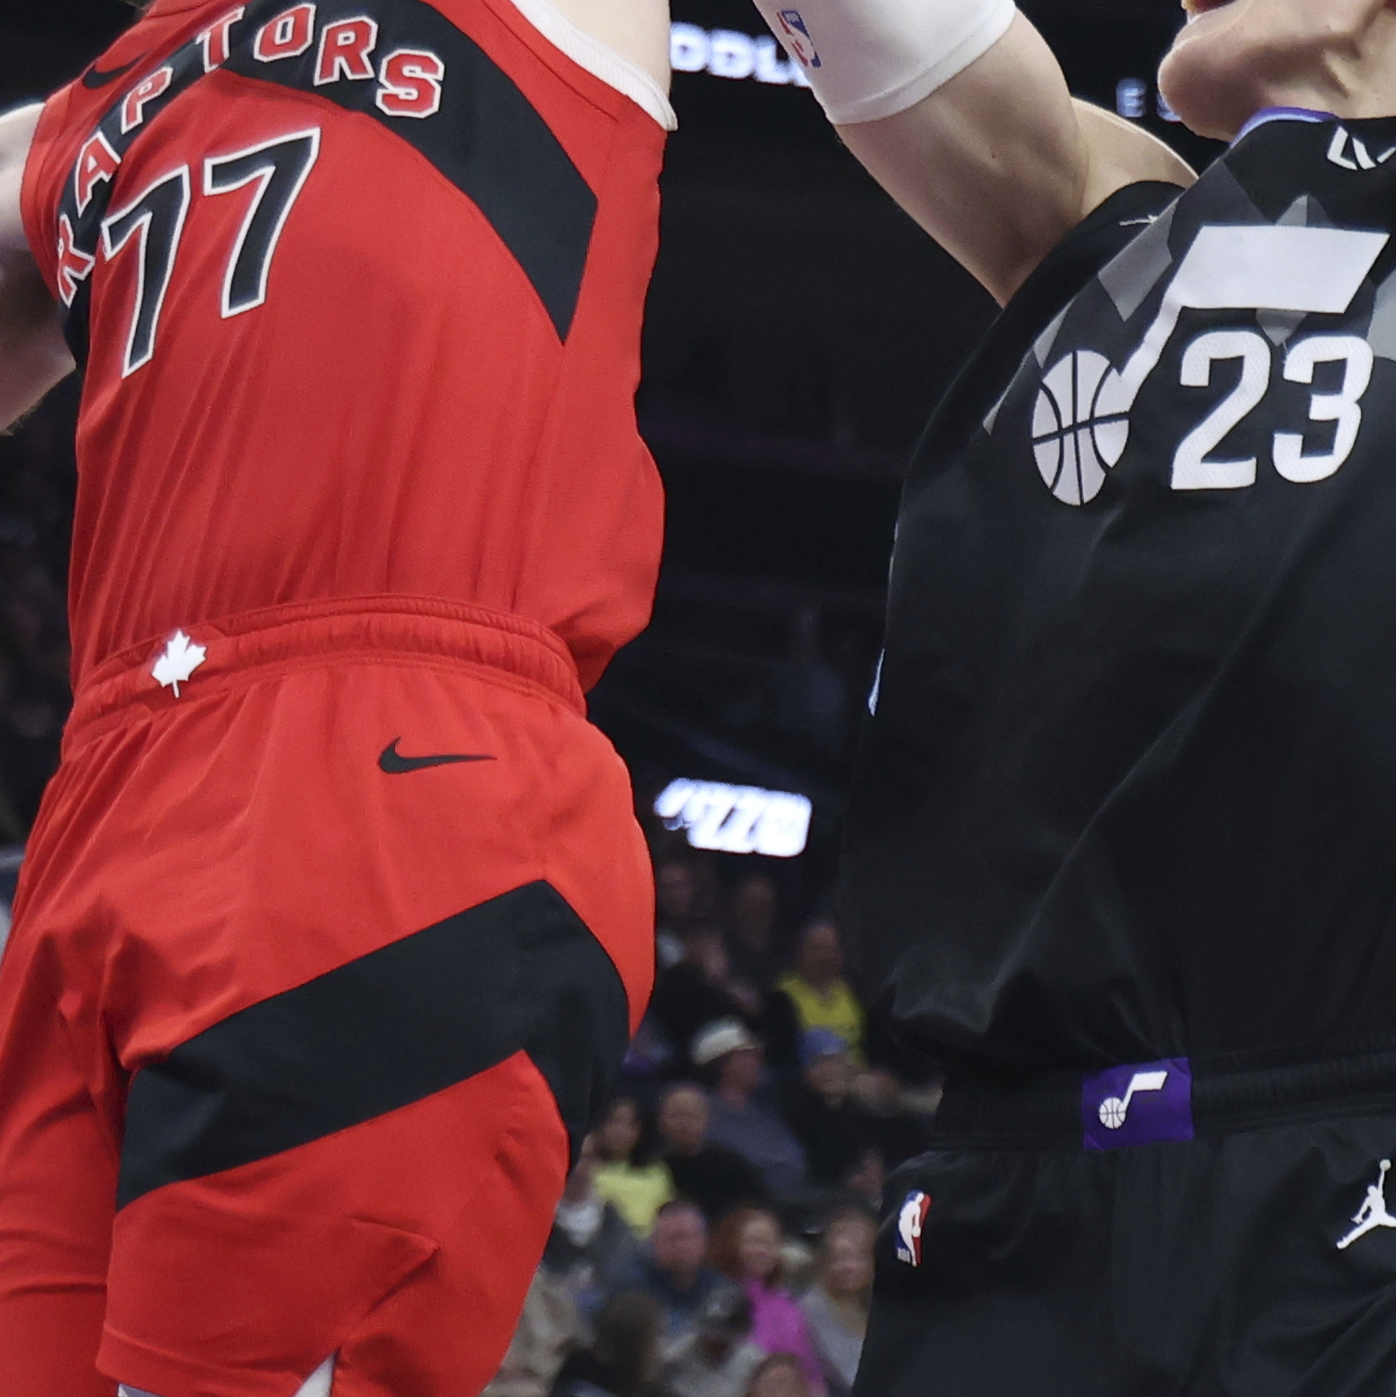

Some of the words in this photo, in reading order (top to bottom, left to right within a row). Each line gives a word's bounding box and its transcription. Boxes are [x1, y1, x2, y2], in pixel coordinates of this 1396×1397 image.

[57, 3, 444, 308] RAPTORS
[102, 127, 320, 378] 77
[1170, 330, 1375, 490] 23
